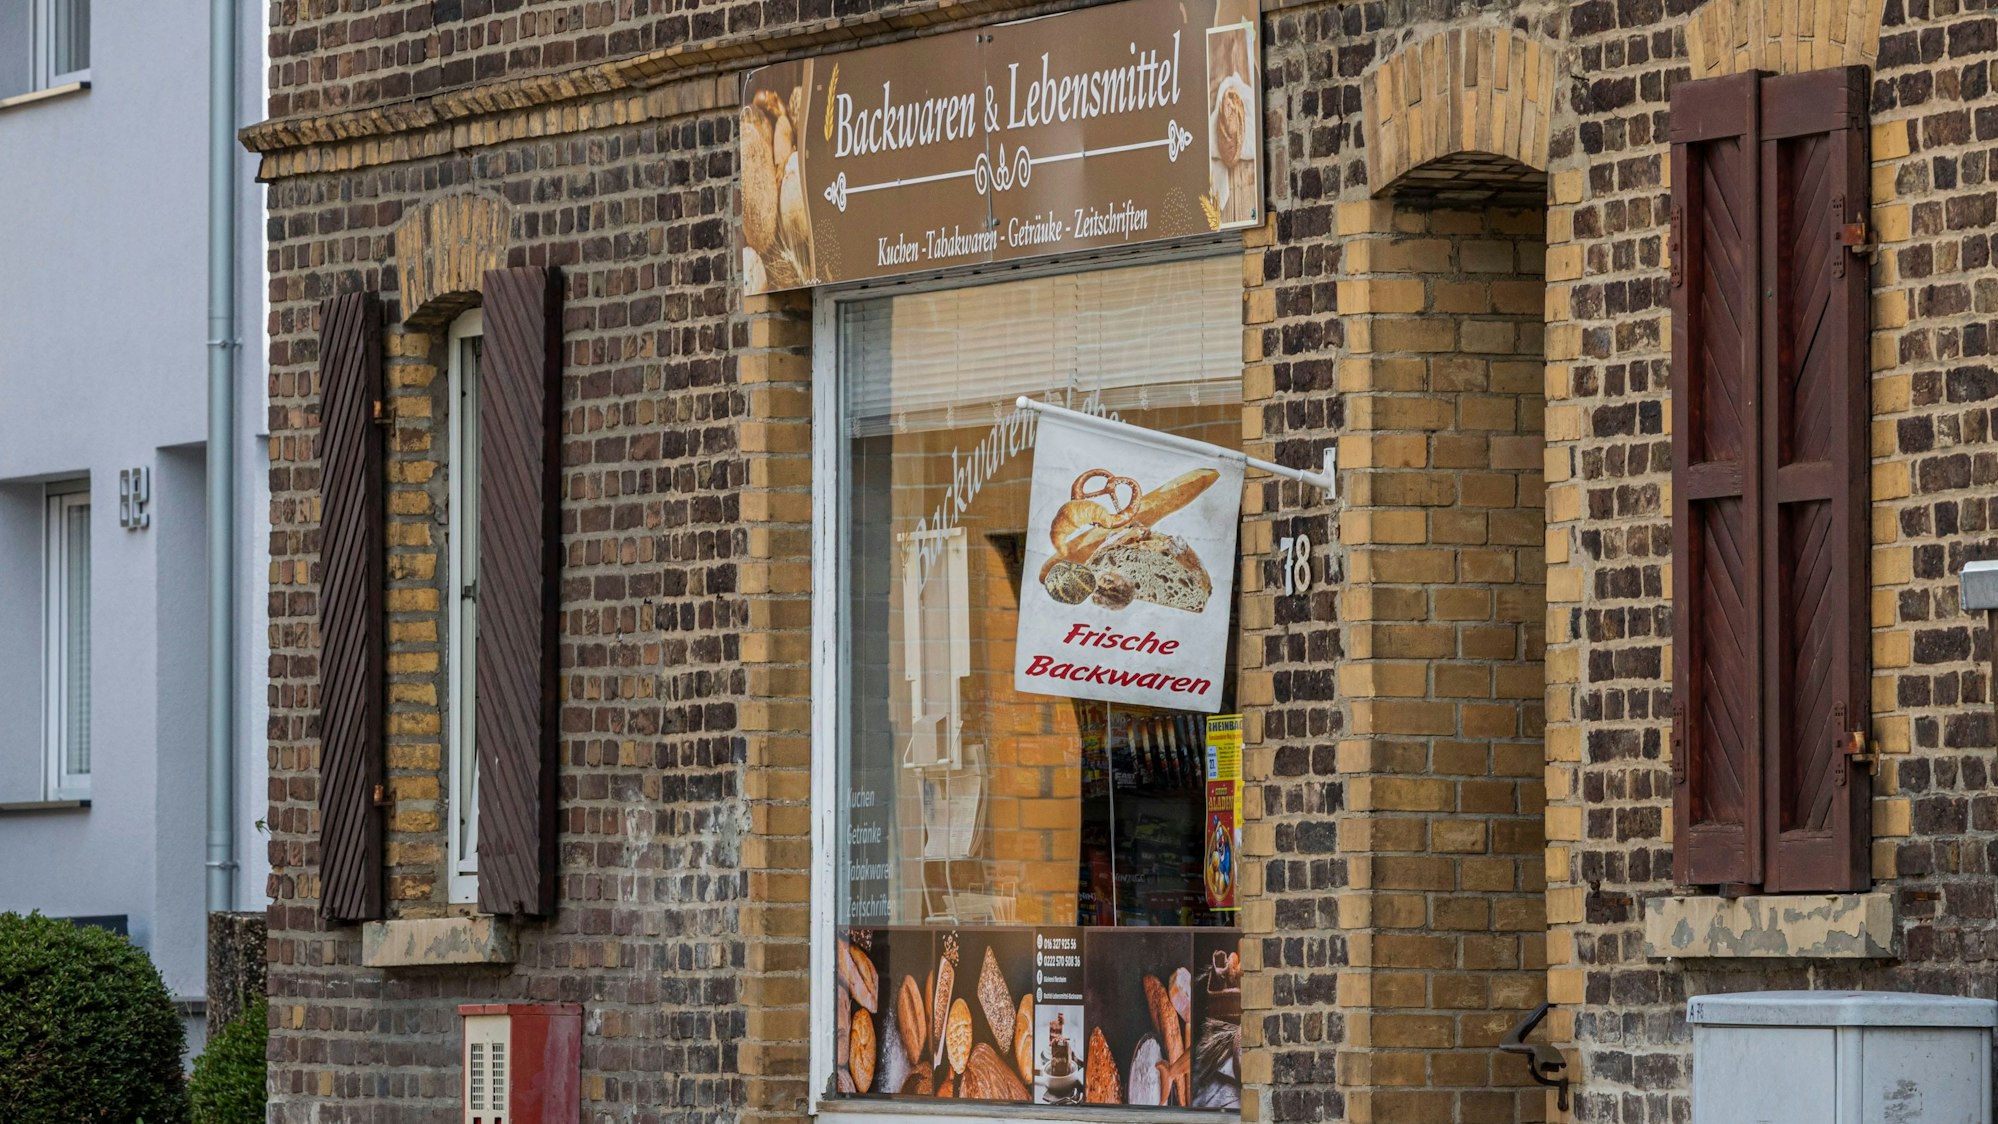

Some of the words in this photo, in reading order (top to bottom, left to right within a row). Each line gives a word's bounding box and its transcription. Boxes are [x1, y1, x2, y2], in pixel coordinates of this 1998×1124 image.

[834, 80, 977, 158] Backwaren
[984, 85, 1000, 133] &
[1007, 29, 1181, 130] Lebensmittel
[877, 232, 919, 266] Kuchen
[1074, 199, 1149, 241] Zeitschriften
[915, 407, 1037, 597] Backwaren
[1280, 534, 1311, 597] 78
[1062, 623, 1180, 655] Frische
[1024, 655, 1212, 696] Backwaren
[847, 785, 875, 808] Kuchen
[847, 821, 881, 845] Getränke
[847, 859, 893, 881] Tabakwaren
[847, 893, 897, 918] Zeitschriften
